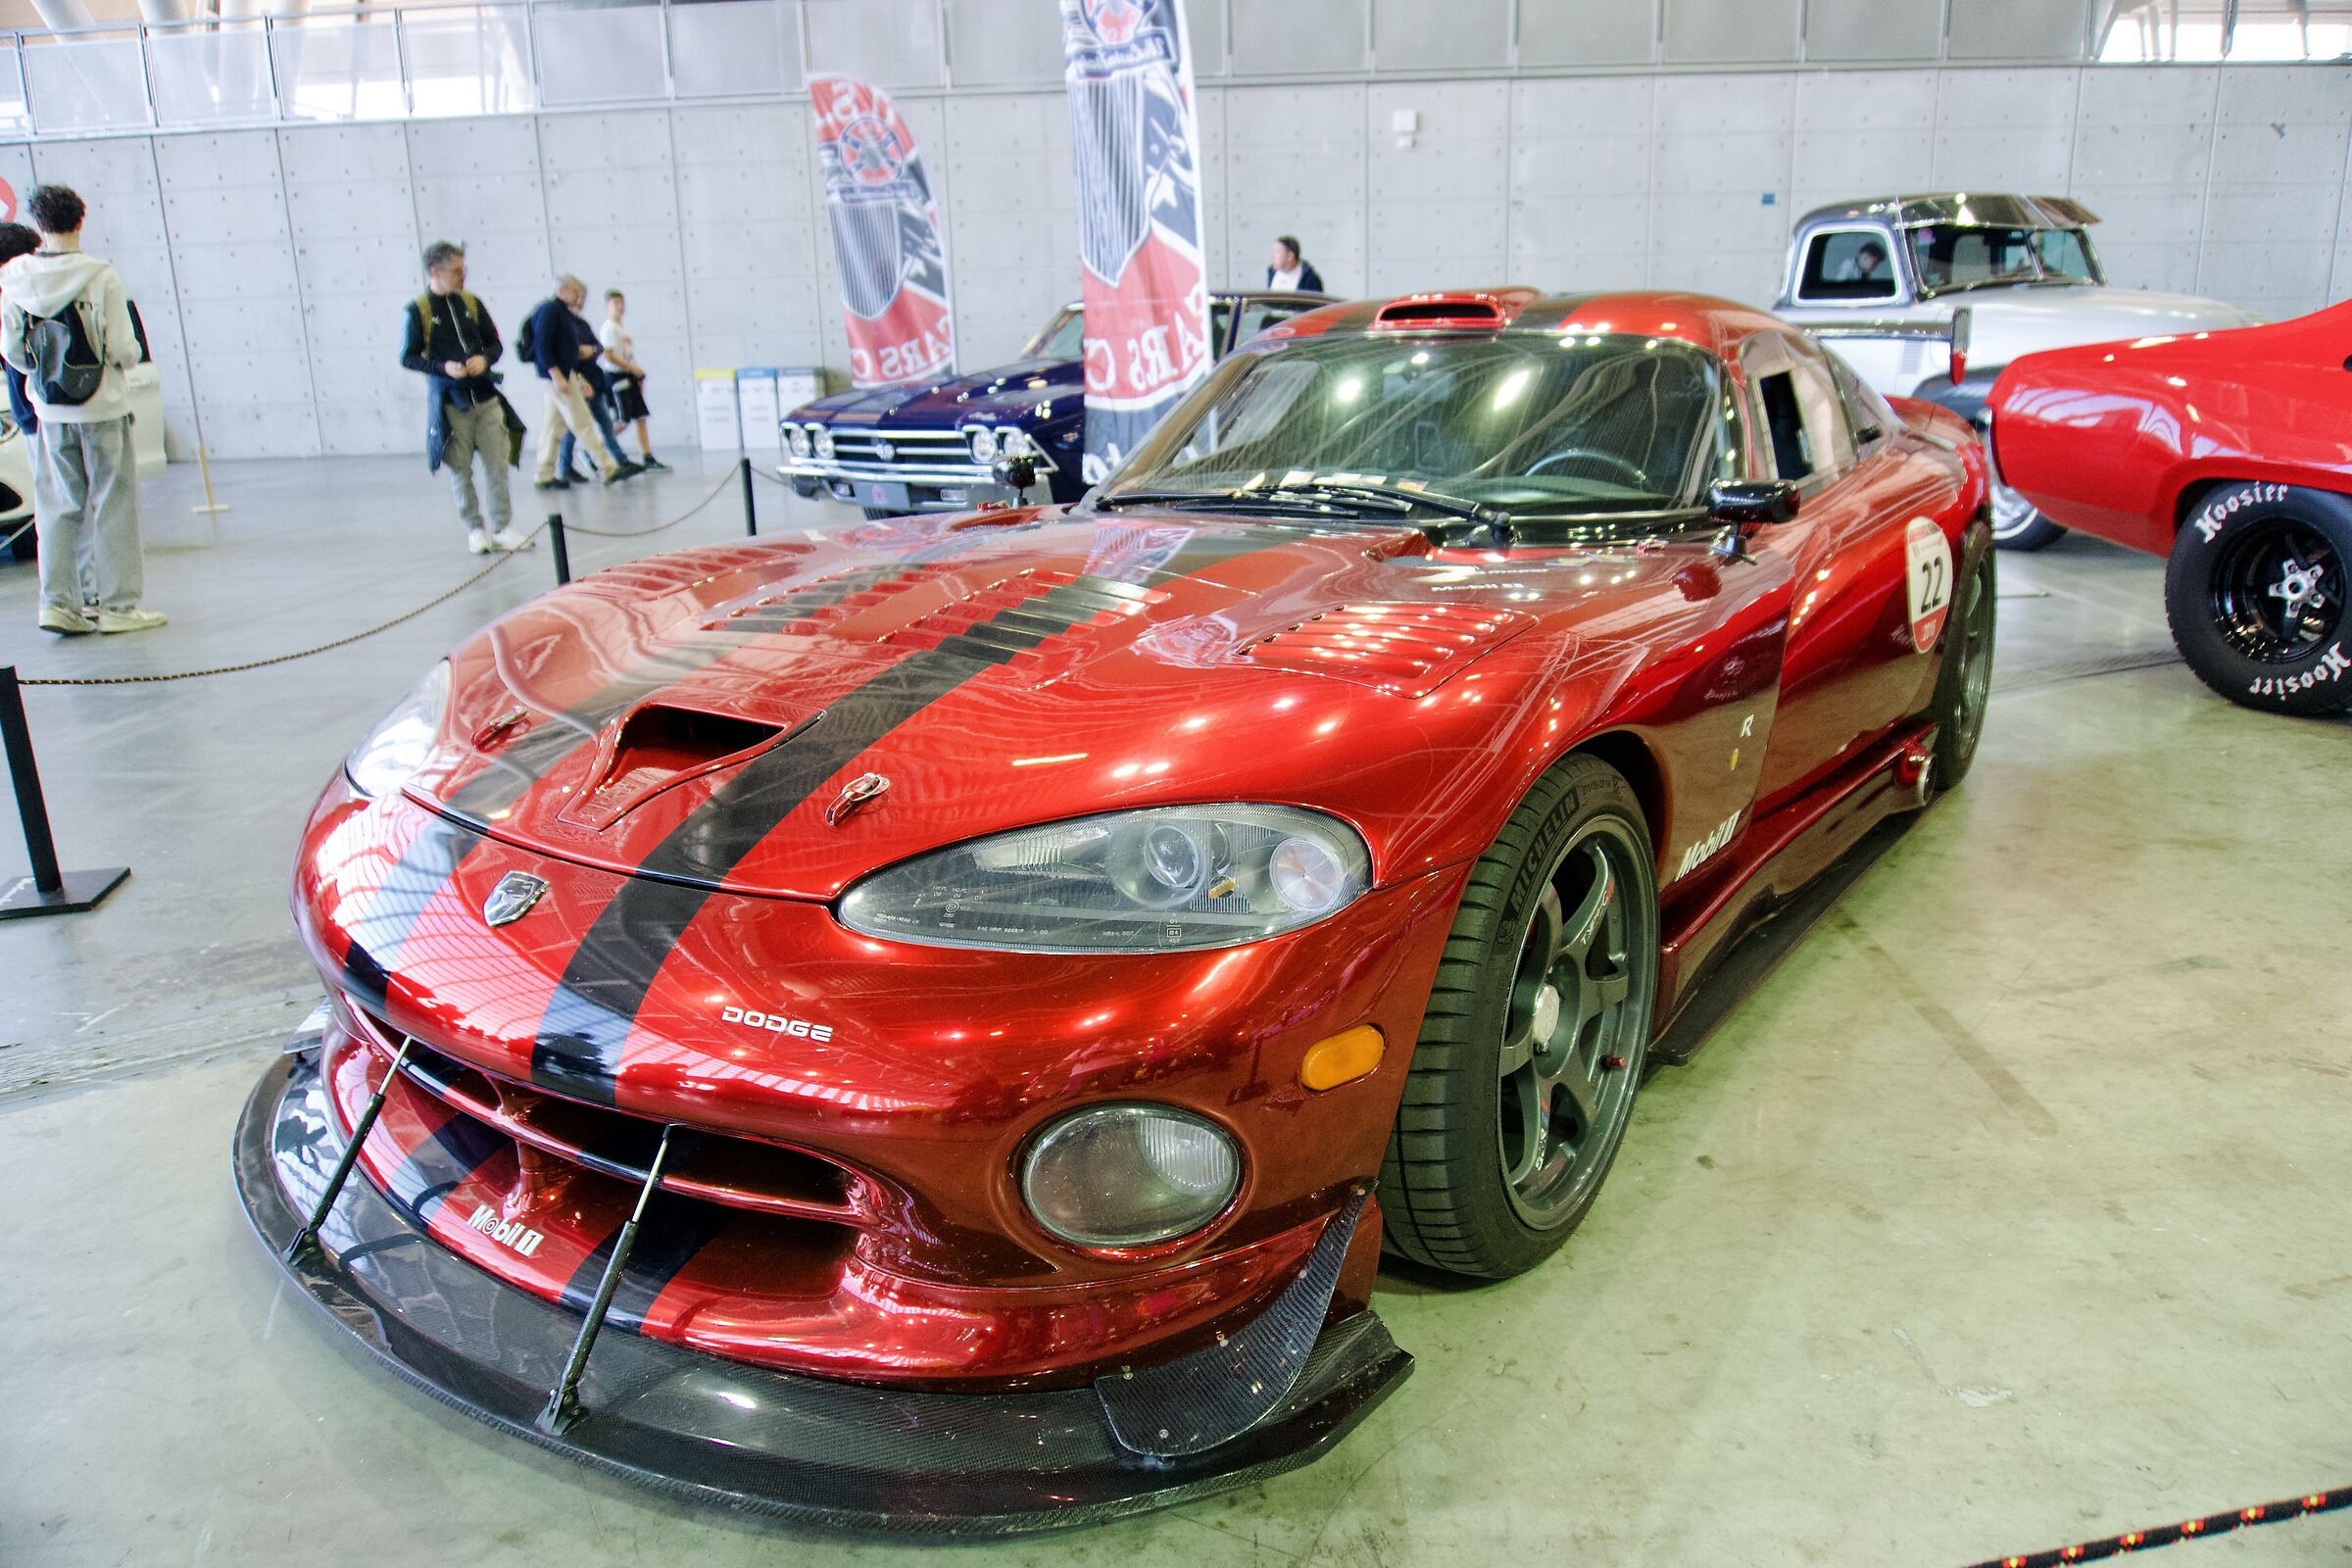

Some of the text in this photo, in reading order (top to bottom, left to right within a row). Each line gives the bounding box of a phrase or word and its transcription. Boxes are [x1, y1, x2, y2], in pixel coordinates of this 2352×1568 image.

[2195, 480, 2288, 544] Hoosier
[1921, 556, 1943, 614] 22
[2249, 641, 2351, 701] Hoosier
[1740, 714, 1754, 737] R
[1510, 791, 1580, 914] MICHELIN
[1675, 819, 1728, 882] Mobil
[721, 1005, 833, 1043] DODGE
[466, 1204, 545, 1257] Mobil 1
